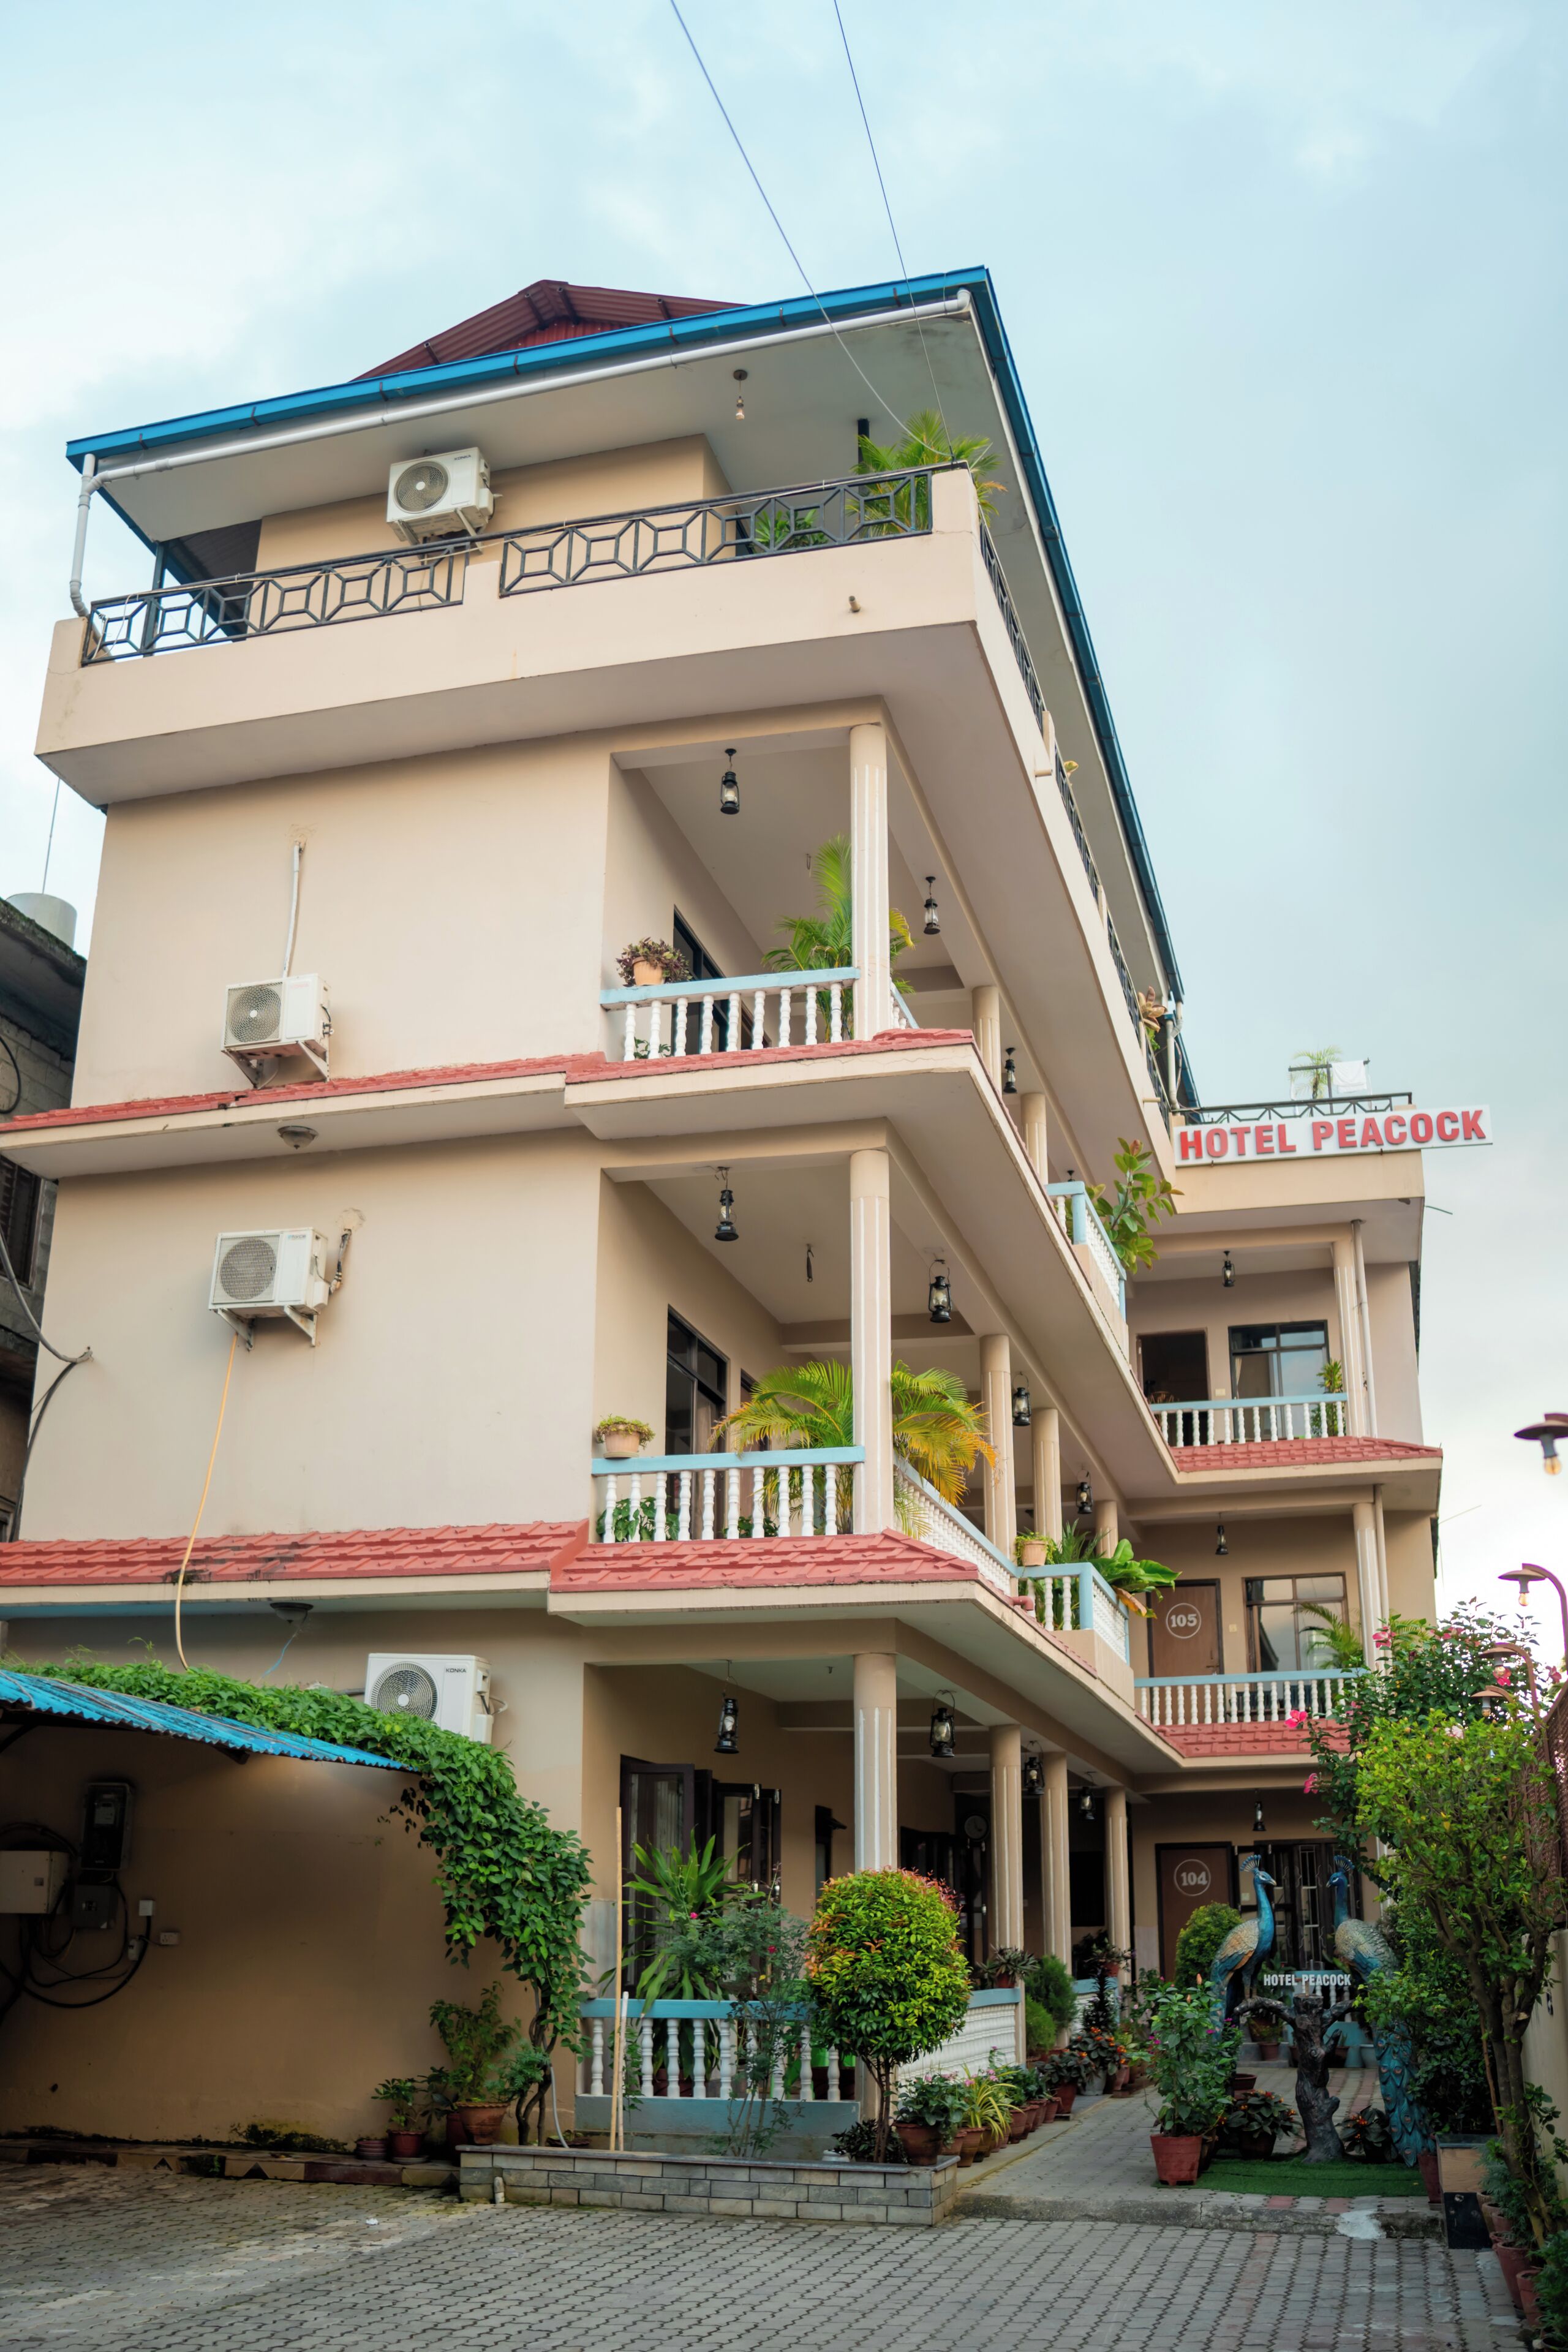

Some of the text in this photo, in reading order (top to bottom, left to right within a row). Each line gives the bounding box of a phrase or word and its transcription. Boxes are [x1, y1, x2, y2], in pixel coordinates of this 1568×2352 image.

[1180, 1109, 1487, 1160] HOTEL PEACOCK
[1170, 1613, 1197, 1627] 105
[1180, 1871, 1208, 1886] 104
[1264, 1973, 1352, 1986] HOTEL PEACOCK
